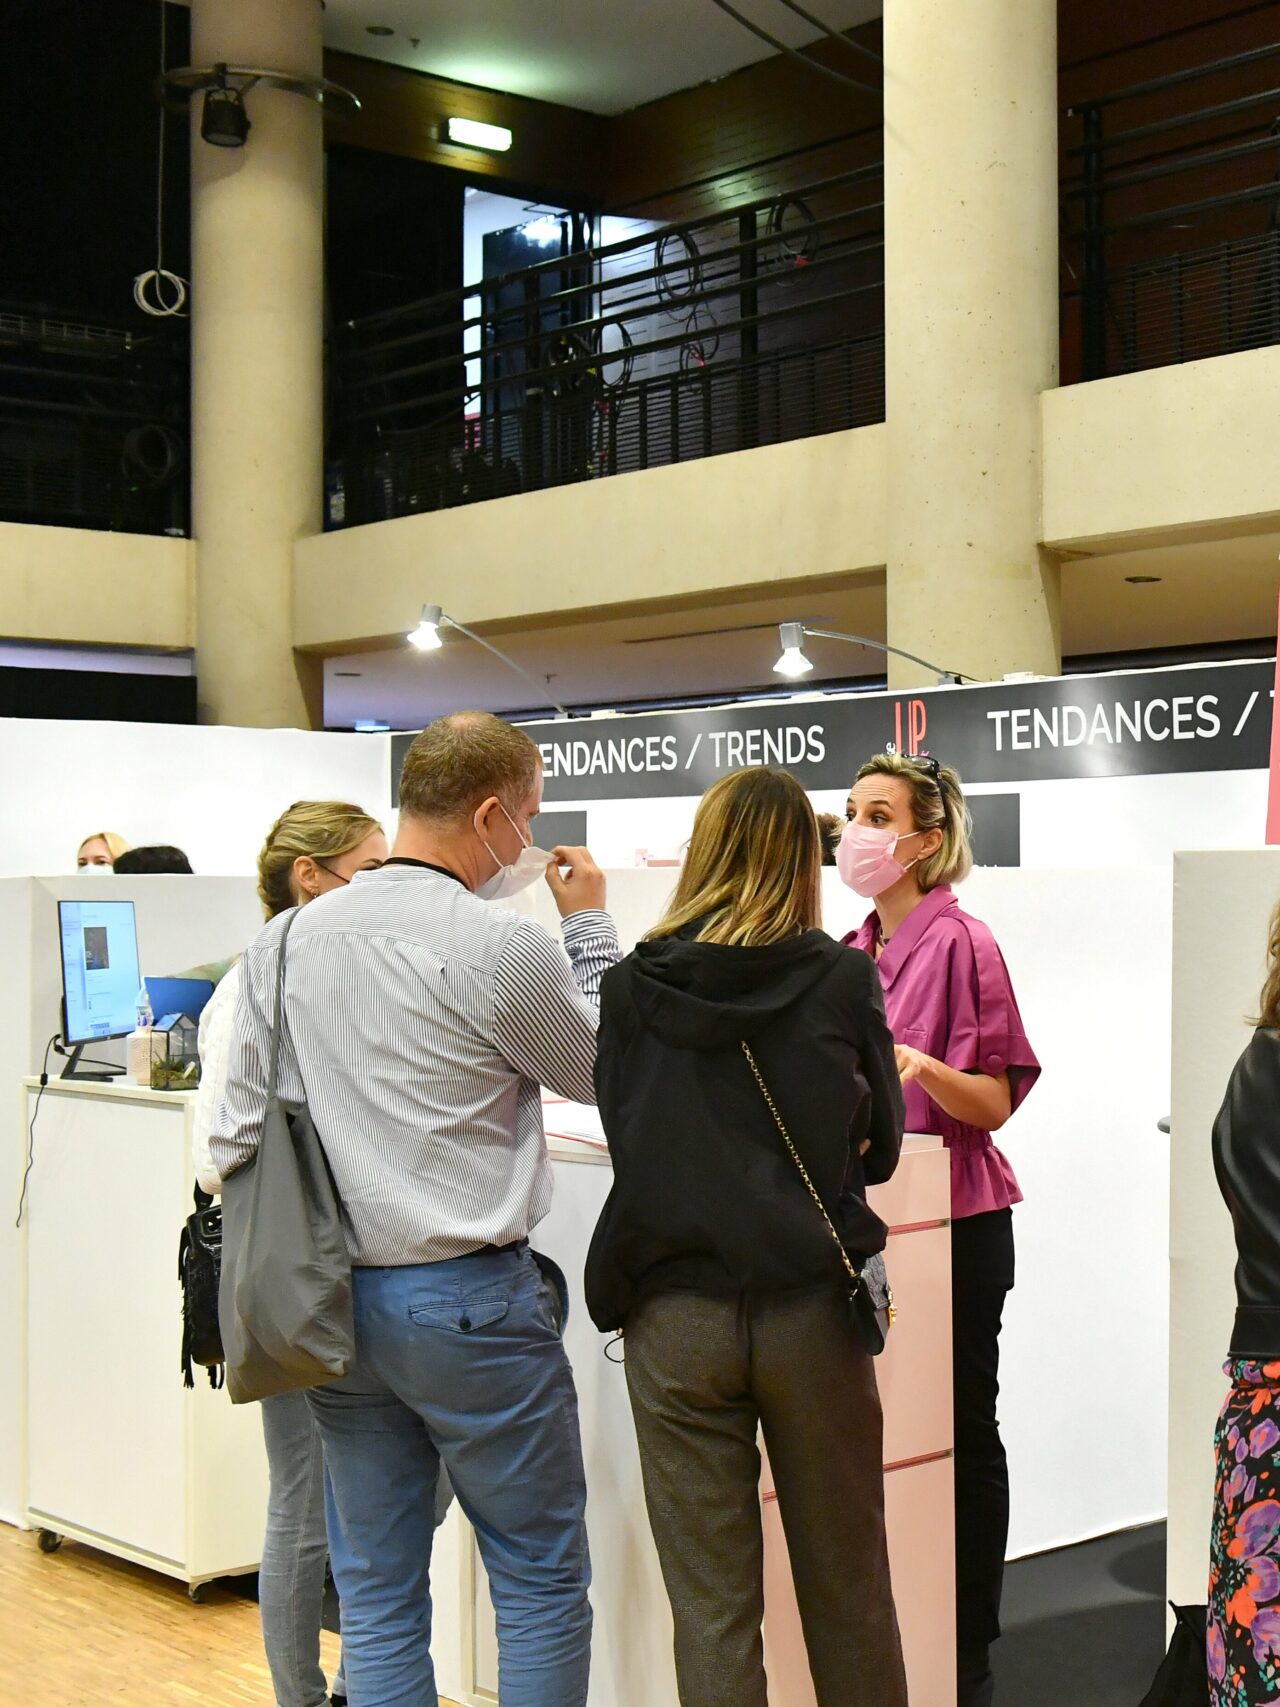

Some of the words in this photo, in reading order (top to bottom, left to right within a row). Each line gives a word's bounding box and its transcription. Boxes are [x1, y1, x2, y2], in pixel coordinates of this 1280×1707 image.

[987, 695, 1221, 751] TENDANCES
[1232, 691, 1259, 736] /
[536, 735, 678, 777] ENDANCES
[685, 733, 702, 770] /
[708, 725, 826, 768] TRENDS
